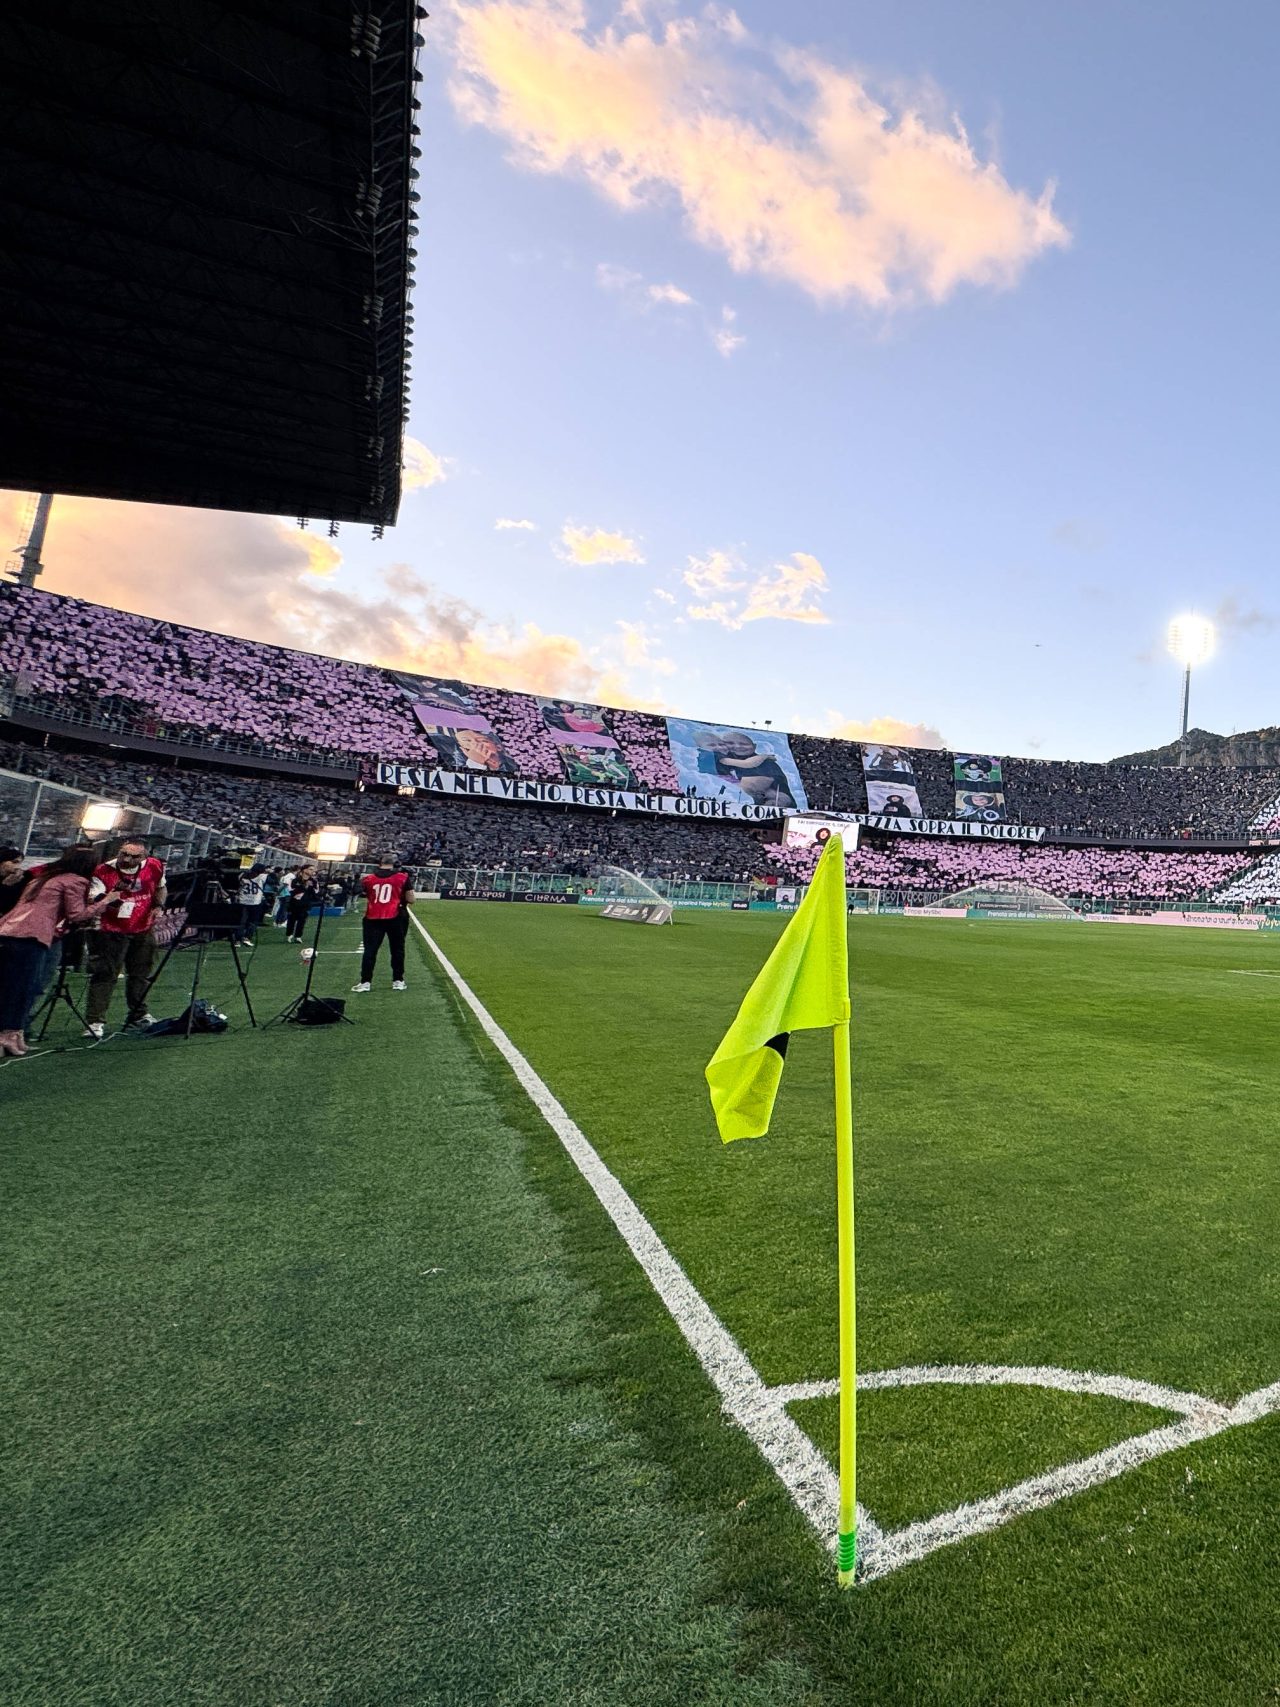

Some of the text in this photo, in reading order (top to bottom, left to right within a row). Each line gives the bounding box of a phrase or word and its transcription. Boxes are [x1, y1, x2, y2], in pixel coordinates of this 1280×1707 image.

[454, 773, 493, 795] NEL
[572, 787, 628, 808] RESTA
[635, 795, 668, 812] NEL
[909, 819, 955, 835] SOPRA
[962, 823, 975, 836] IL
[981, 824, 1042, 841] DOLORE!
[372, 883, 393, 904] 10
[482, 891, 506, 899] SPOSI
